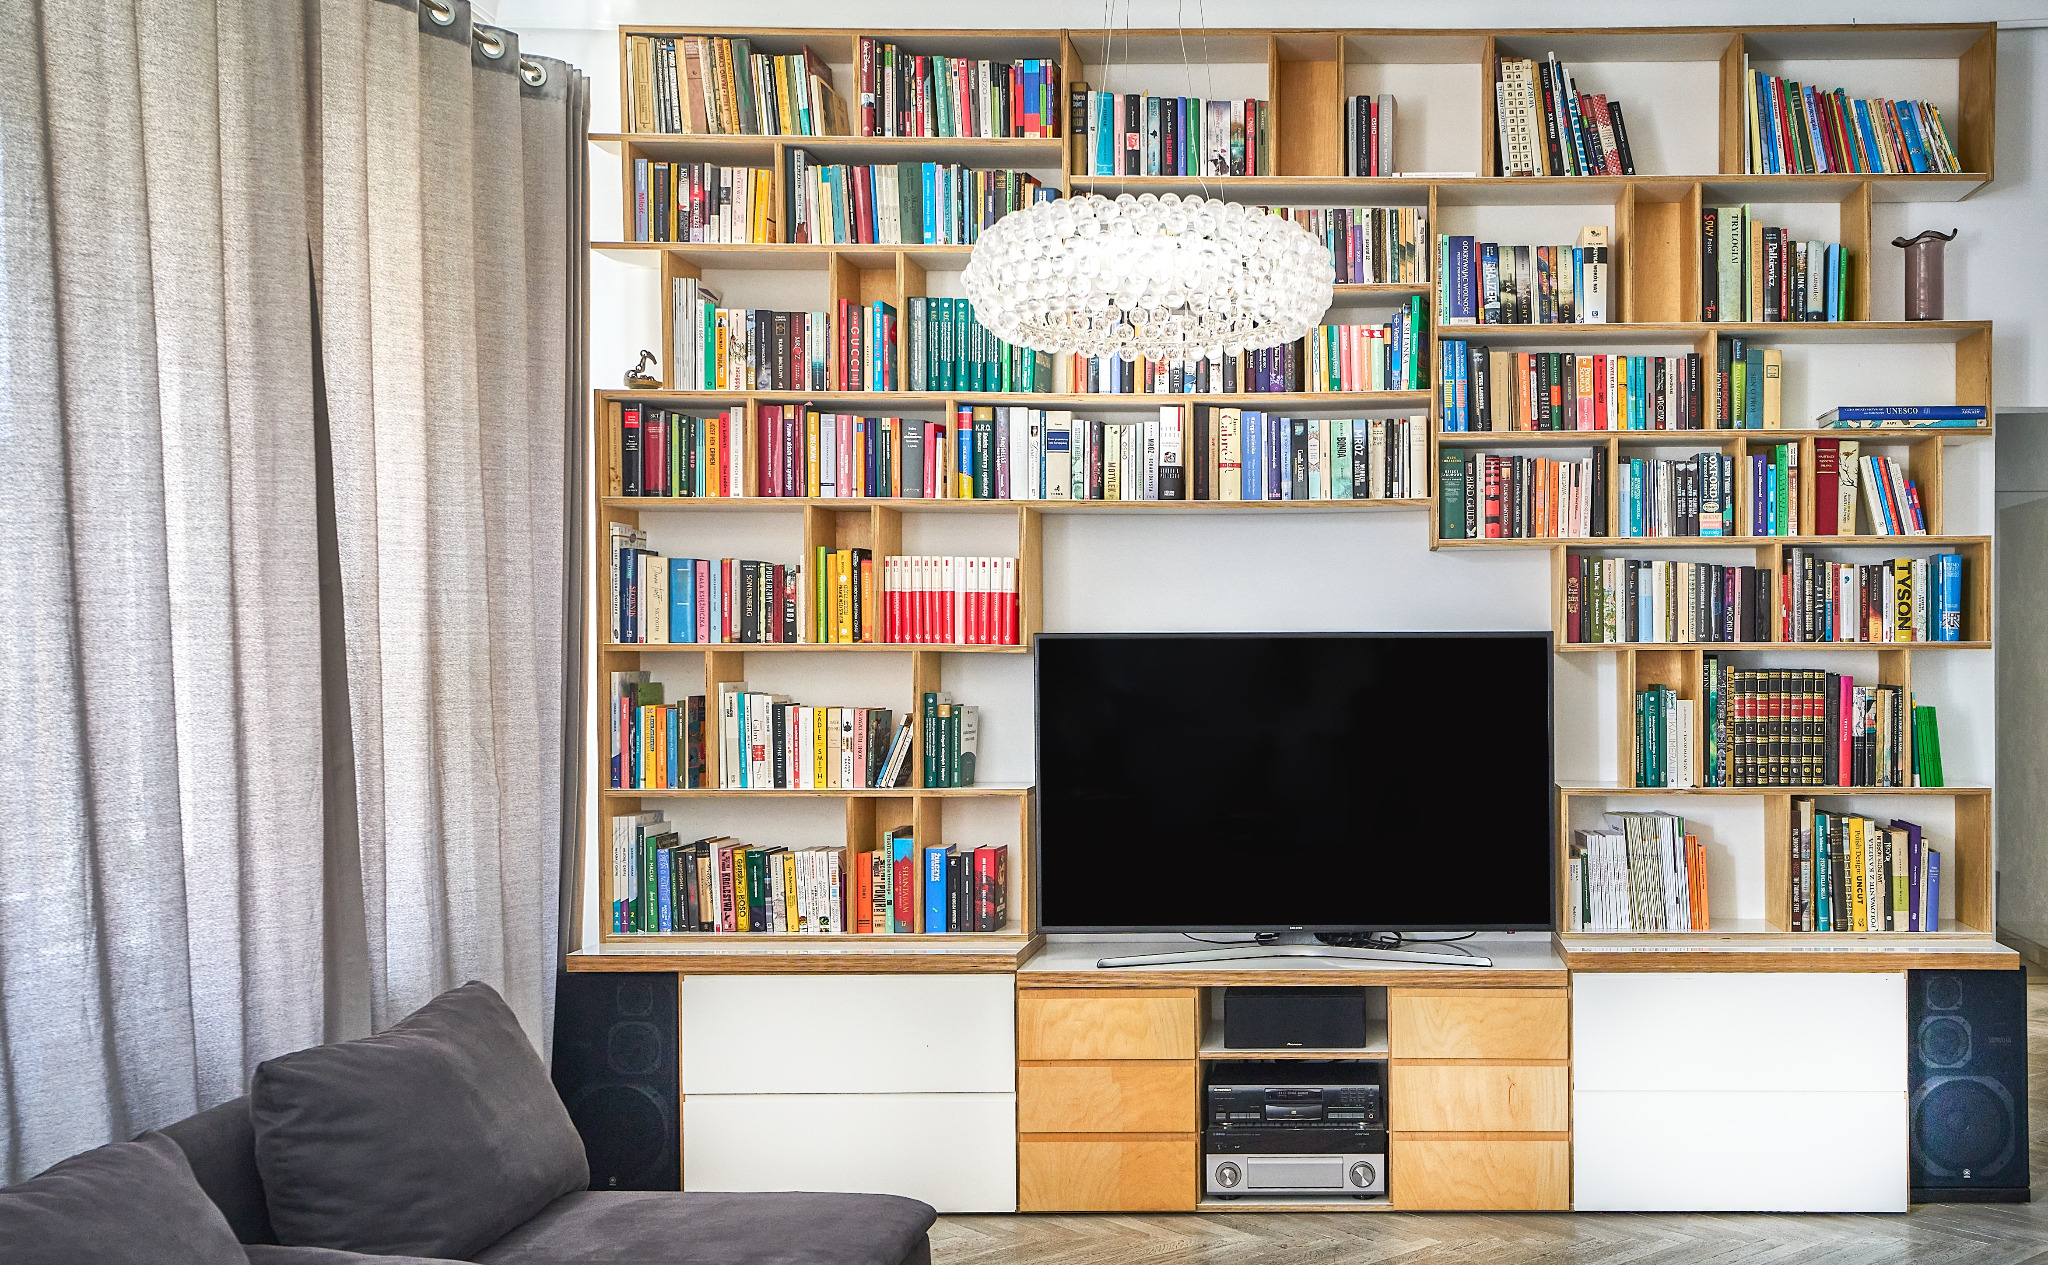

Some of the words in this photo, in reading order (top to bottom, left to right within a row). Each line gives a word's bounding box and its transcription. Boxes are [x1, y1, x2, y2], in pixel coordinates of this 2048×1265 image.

[1526, 80, 1535, 108] MORZE
[1547, 113, 1553, 121] XX
[1592, 133, 1601, 150] NIE
[1597, 155, 1605, 170] MA
[1704, 214, 1715, 237] SOWY
[1461, 241, 1469, 282] ODKRYWAJĄC
[1768, 242, 1777, 287] Pałkiewicz
[1462, 283, 1470, 315] WOLNOŚĆ
[851, 326, 860, 372] GUCCI
[1402, 335, 1410, 365] LANKA
[1721, 372, 1729, 420] KAPUŚCIŃSKI
[1221, 415, 1232, 455] Cabré
[1337, 437, 1347, 458] BONDA
[1354, 429, 1364, 456] MRÓZ
[1108, 462, 1116, 493] MOTYLEK
[1466, 476, 1474, 496] BIRD
[1708, 456, 1717, 498] OXFORD
[1466, 497, 1474, 526] GUIDE
[698, 590, 706, 627] KSIĘŻNICZKA
[1897, 562, 1911, 631] TYSON
[1726, 671, 1734, 708] TAMARA
[752, 719, 760, 742] Cabré
[1726, 710, 1734, 753] ŁEMPICKA
[1854, 830, 1862, 849] Polish
[934, 852, 942, 881] ŻULCZYK
[1854, 851, 1862, 874] Design:
[722, 872, 732, 912] KRÓLESTWO
